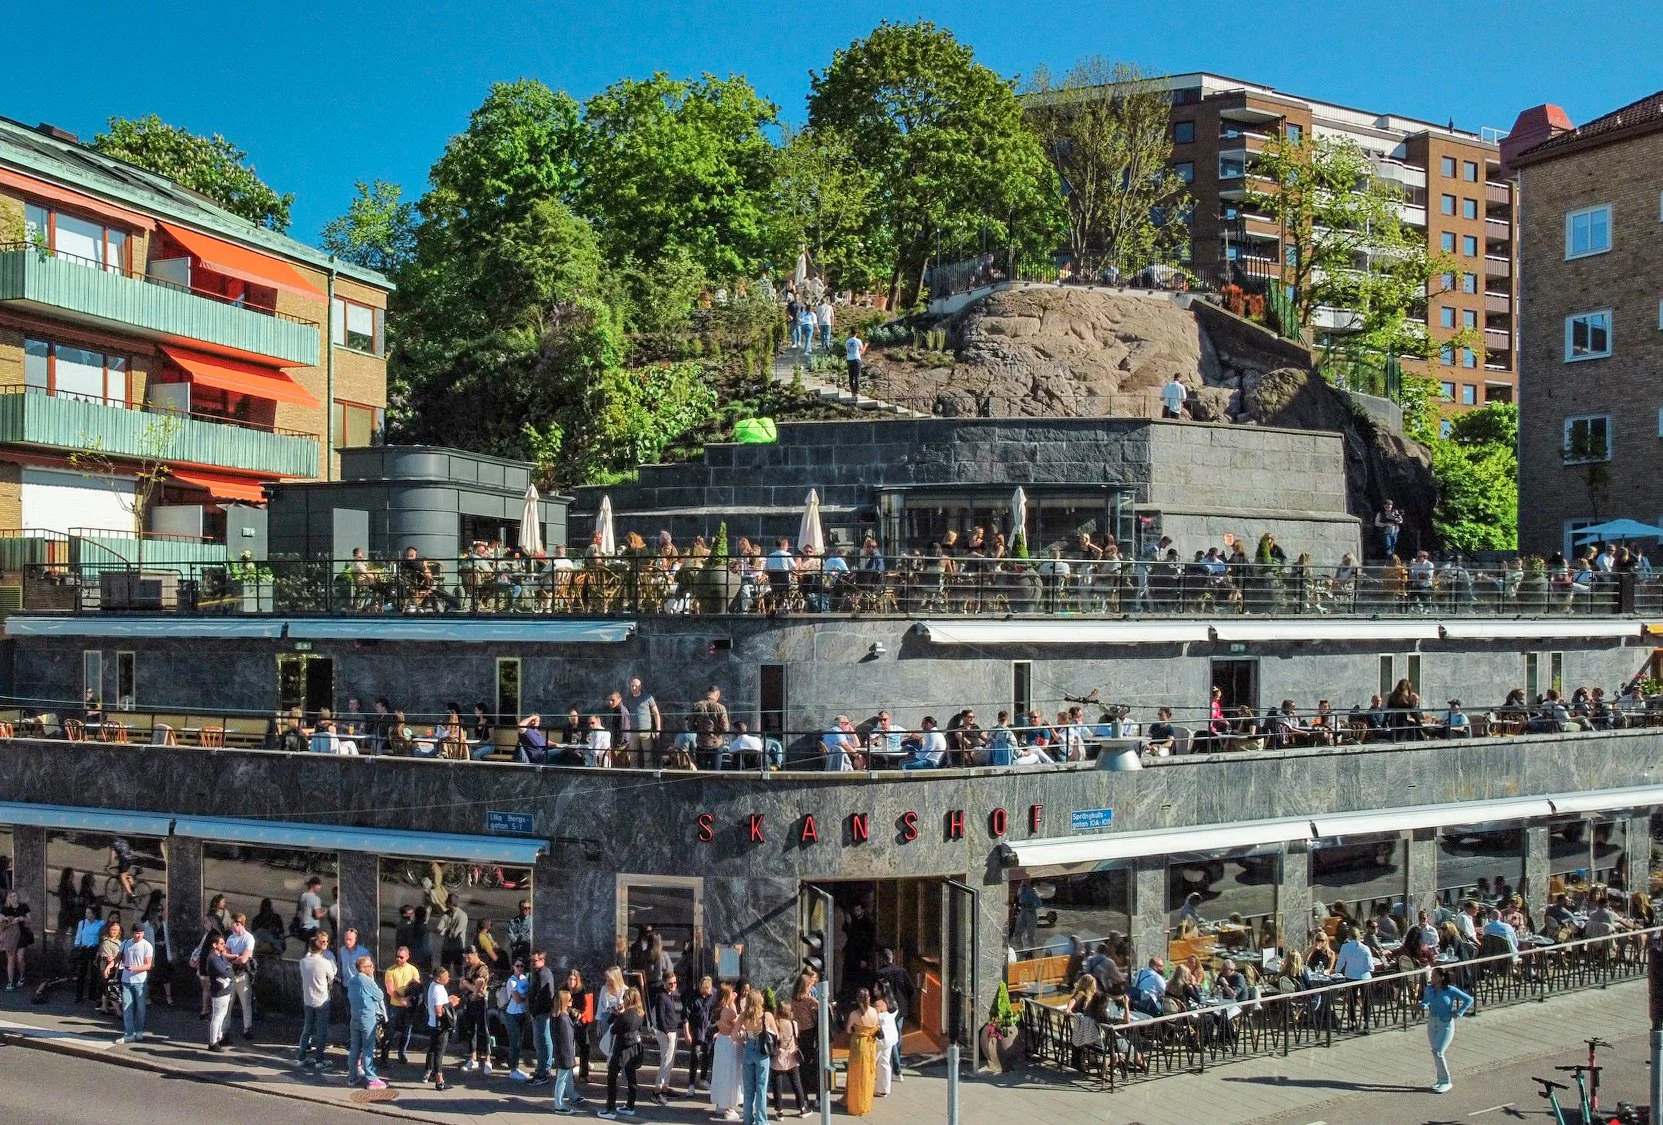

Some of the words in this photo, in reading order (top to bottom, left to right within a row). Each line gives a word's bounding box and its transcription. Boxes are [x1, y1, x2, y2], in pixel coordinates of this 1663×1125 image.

[489, 822, 509, 830] gatan
[698, 804, 1043, 843] SKANSHOF
[1072, 821, 1089, 829] gatan
